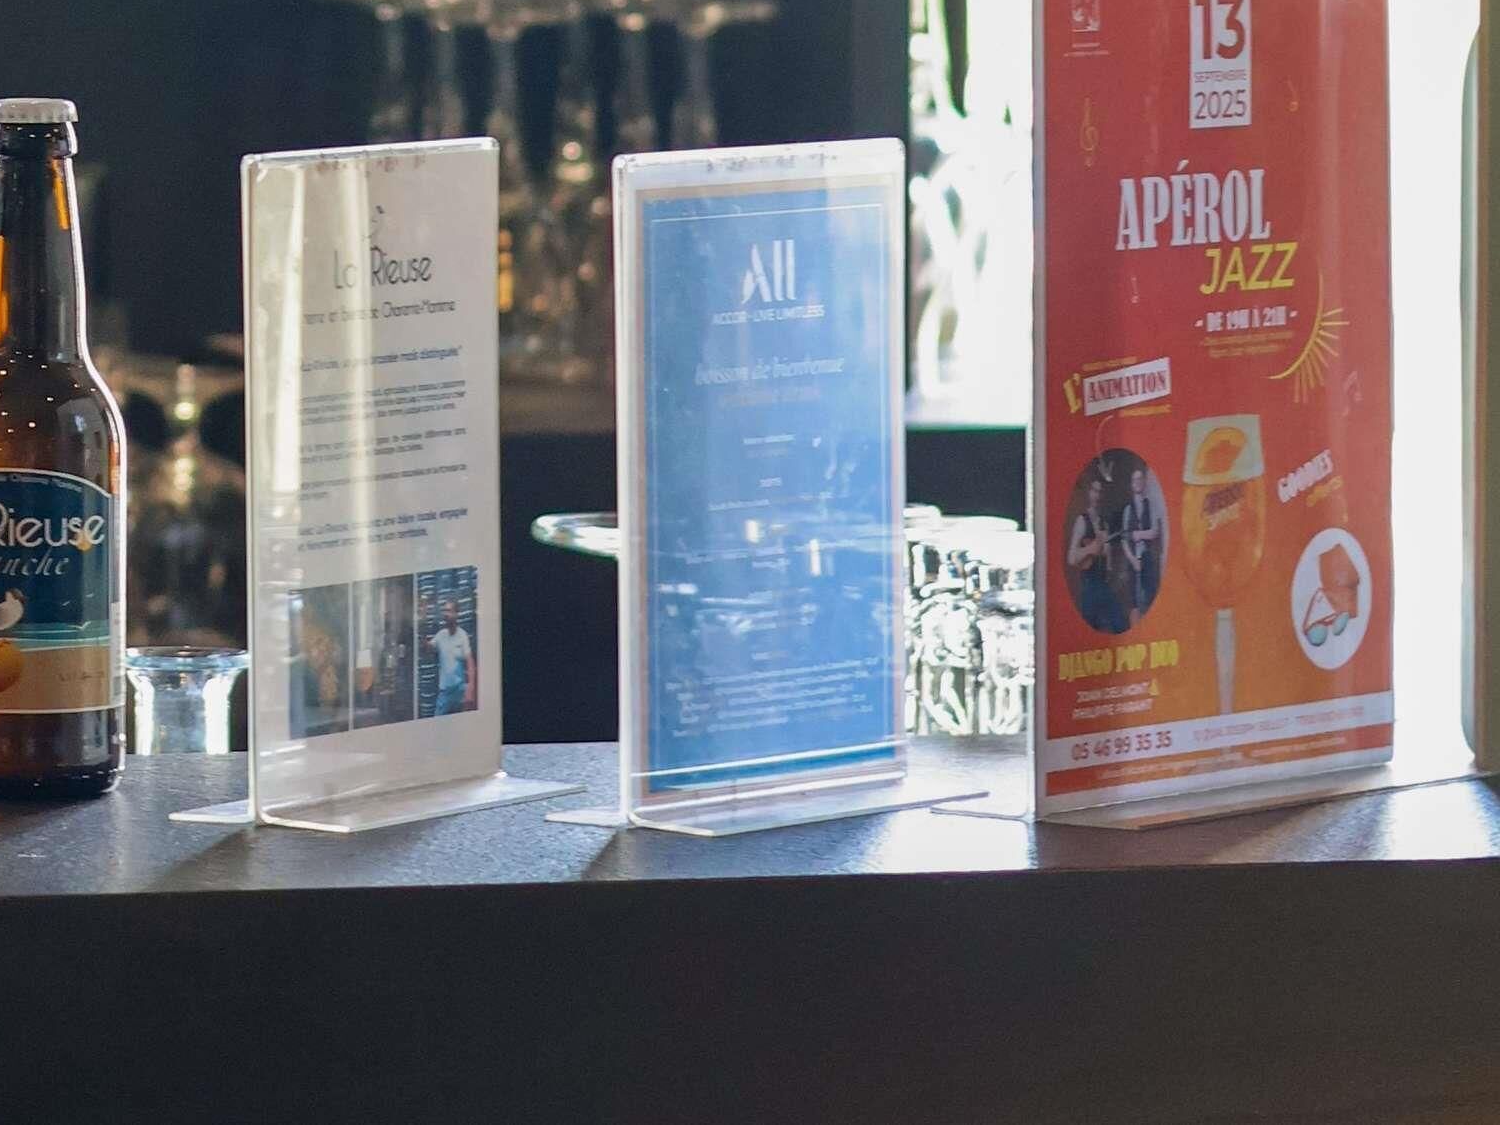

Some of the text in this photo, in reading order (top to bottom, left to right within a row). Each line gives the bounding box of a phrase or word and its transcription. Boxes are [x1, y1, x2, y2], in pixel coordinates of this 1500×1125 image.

[1193, 69, 1247, 83] SEPTEMBRE
[1194, 89, 1247, 120] 2025
[1115, 159, 1271, 250] APÉROL
[369, 244, 433, 288] Rieuse
[1199, 241, 1298, 294] JAZZ
[1087, 370, 1168, 404] ANIMATION
[1115, 643, 1148, 673] POP
[1071, 741, 1090, 762] 05
[1093, 737, 1112, 758] 46
[1113, 735, 1131, 755] 99
[1134, 732, 1153, 752] 35
[1155, 729, 1173, 750] 35
